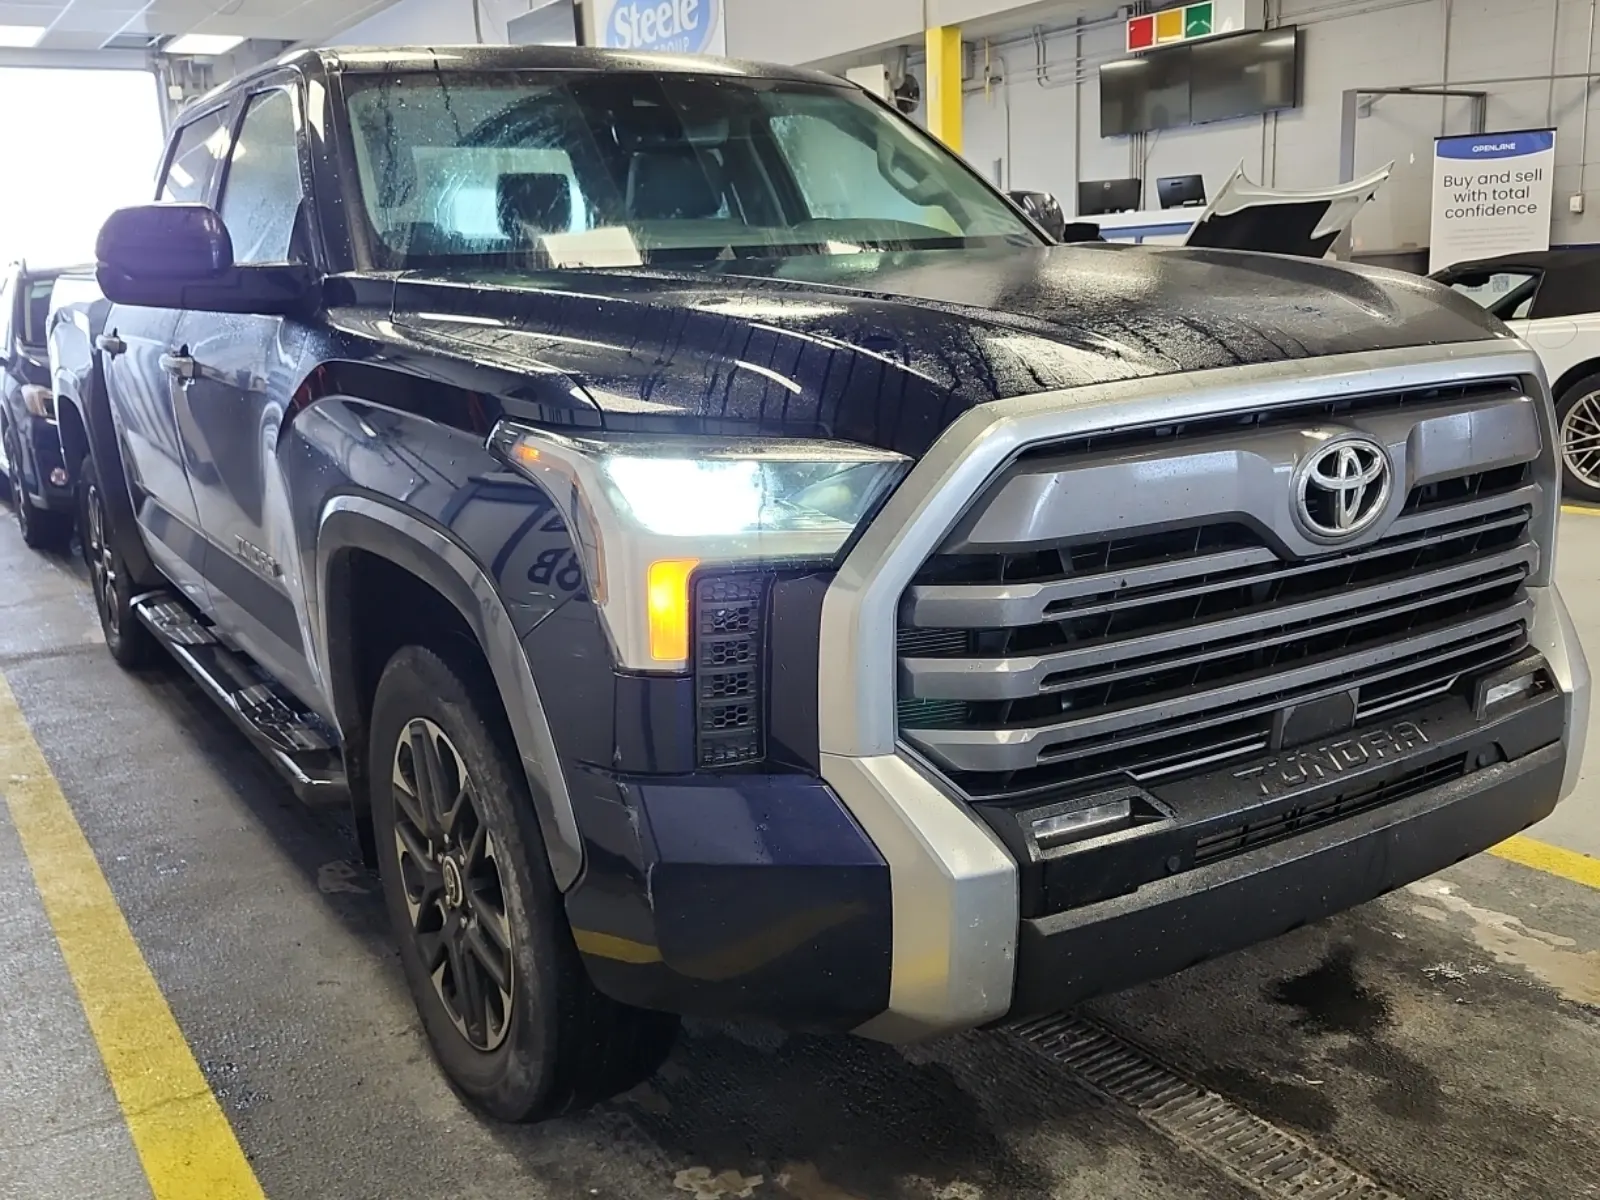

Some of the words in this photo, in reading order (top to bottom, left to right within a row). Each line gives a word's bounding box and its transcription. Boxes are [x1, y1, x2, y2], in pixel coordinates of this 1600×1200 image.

[614, 0, 699, 49] Steele
[1472, 142, 1516, 152] OPENLANE
[1443, 175, 1473, 189] Buy
[1477, 170, 1511, 185] and
[1515, 168, 1542, 182] sell
[1454, 189, 1487, 203] with
[1492, 186, 1530, 201] total
[1445, 203, 1537, 219] confidence
[1232, 720, 1430, 796] TUNDRA
